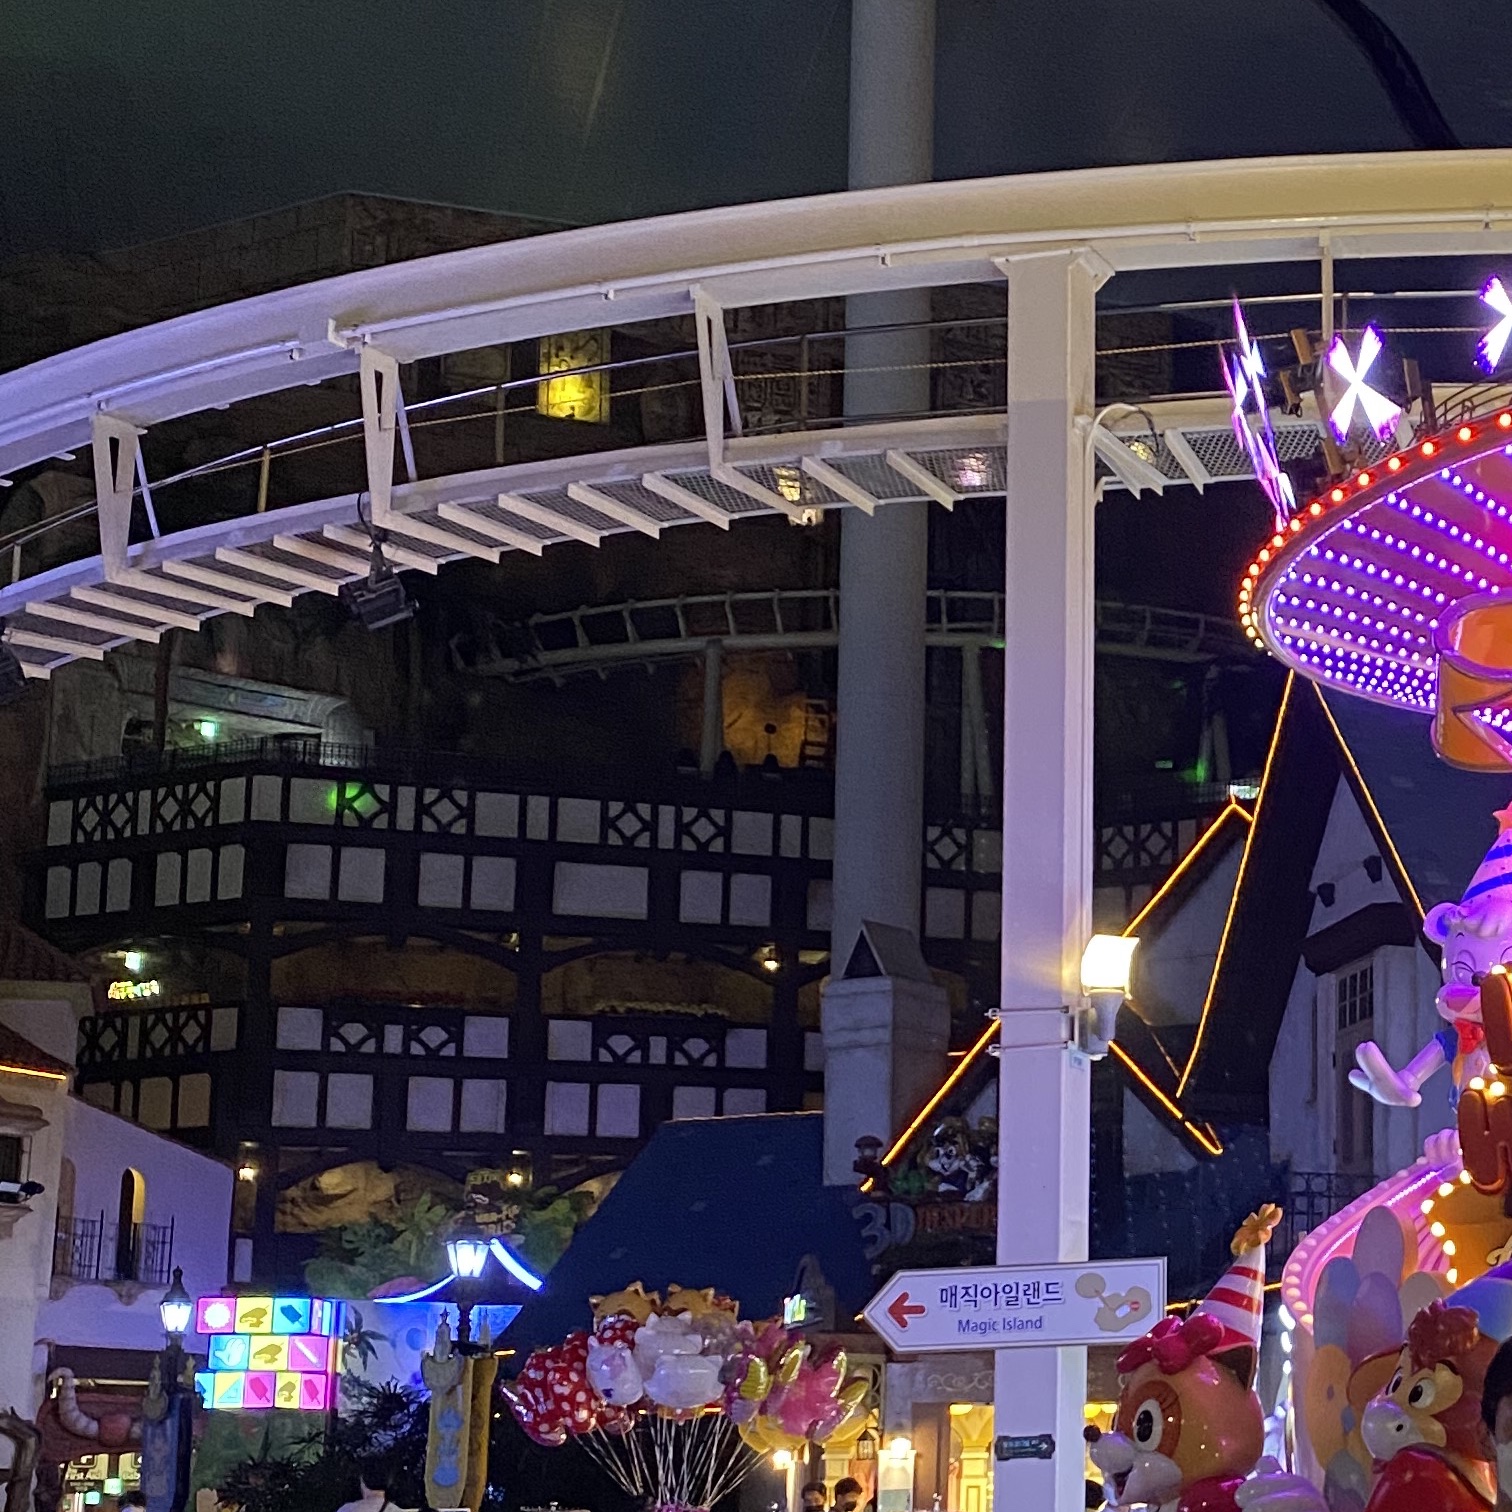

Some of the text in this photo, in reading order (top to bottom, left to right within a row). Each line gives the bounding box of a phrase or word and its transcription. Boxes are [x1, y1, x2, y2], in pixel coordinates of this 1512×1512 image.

[939, 1280, 1063, 1309] 매직아일랜드
[958, 1316, 1043, 1335] Magic Island
